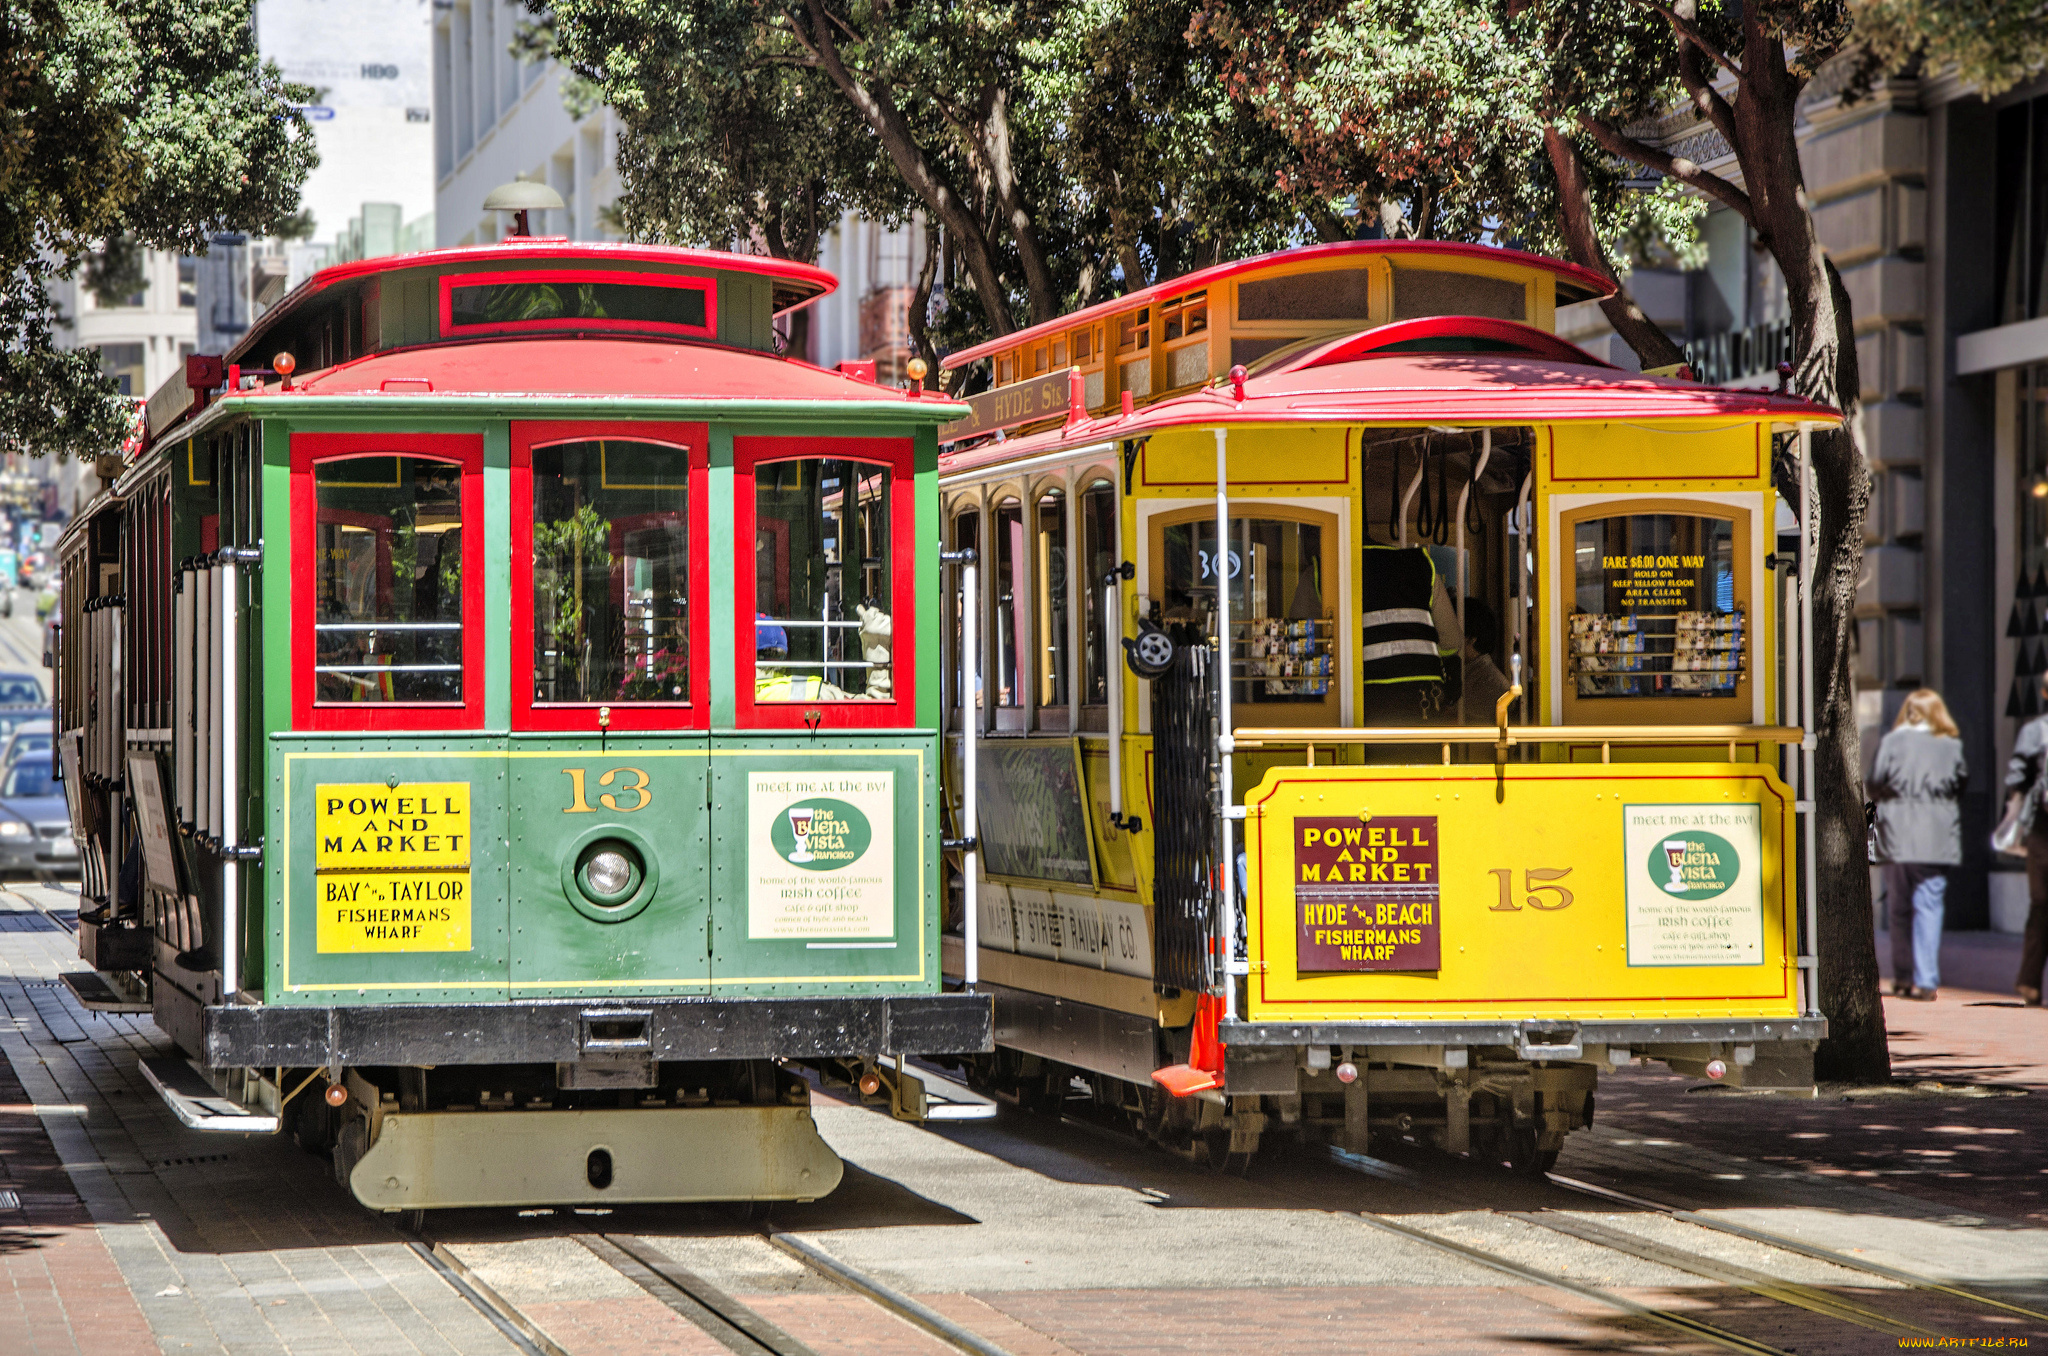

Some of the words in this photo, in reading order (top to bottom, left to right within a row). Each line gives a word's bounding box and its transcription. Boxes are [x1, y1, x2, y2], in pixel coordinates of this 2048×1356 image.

[361, 64, 399, 80] HBO
[994, 387, 1034, 423] HYDE
[1041, 382, 1065, 410] Sts.
[330, 548, 351, 560] WAY
[1603, 555, 1628, 569] FARE
[1629, 555, 1655, 569] $6.00
[1656, 555, 1680, 569] ONE
[1681, 555, 1706, 569] WAY
[1634, 570, 1658, 579] HOLD
[1659, 570, 1674, 579] ON
[1612, 579, 1633, 588] KEEP
[1634, 579, 1667, 588] YELLOW
[1667, 579, 1695, 588] FLOOR
[1625, 588, 1650, 597] AREA
[1652, 588, 1682, 597] CLEAR
[1620, 598, 1636, 607] NO
[1638, 598, 1688, 607] TRANSFERS
[561, 766, 652, 814] 13
[756, 780, 792, 793] meet
[796, 780, 817, 793] me
[839, 779, 863, 793] the
[326, 797, 461, 816] POWELL
[813, 808, 835, 821] the
[1633, 814, 1666, 826] meet
[1670, 814, 1689, 826] me
[1709, 812, 1732, 826] the
[363, 818, 429, 832] AND
[323, 835, 464, 853] MARKET
[1303, 827, 1430, 848] POWELL
[1686, 840, 1706, 852] the
[1336, 847, 1399, 863] AND
[1301, 863, 1432, 883] MARKET
[759, 876, 786, 885] home
[788, 876, 799, 886] of
[800, 876, 816, 885] the
[326, 882, 361, 902] BAY
[389, 881, 464, 901] TAYLOR
[1487, 866, 1575, 912] 15
[337, 907, 451, 923] FISHERMANS
[807, 903, 814, 913] &
[835, 903, 859, 914] shop
[1304, 903, 1348, 926] HYDE
[1351, 904, 1374, 926] AND
[1376, 903, 1433, 926] BEACH
[364, 925, 423, 939] WHARF
[1028, 902, 1067, 948] STREET
[1069, 908, 1115, 957] RAILWAY
[1315, 929, 1422, 945] FISHERMANS
[1340, 945, 1396, 960] WHARF
